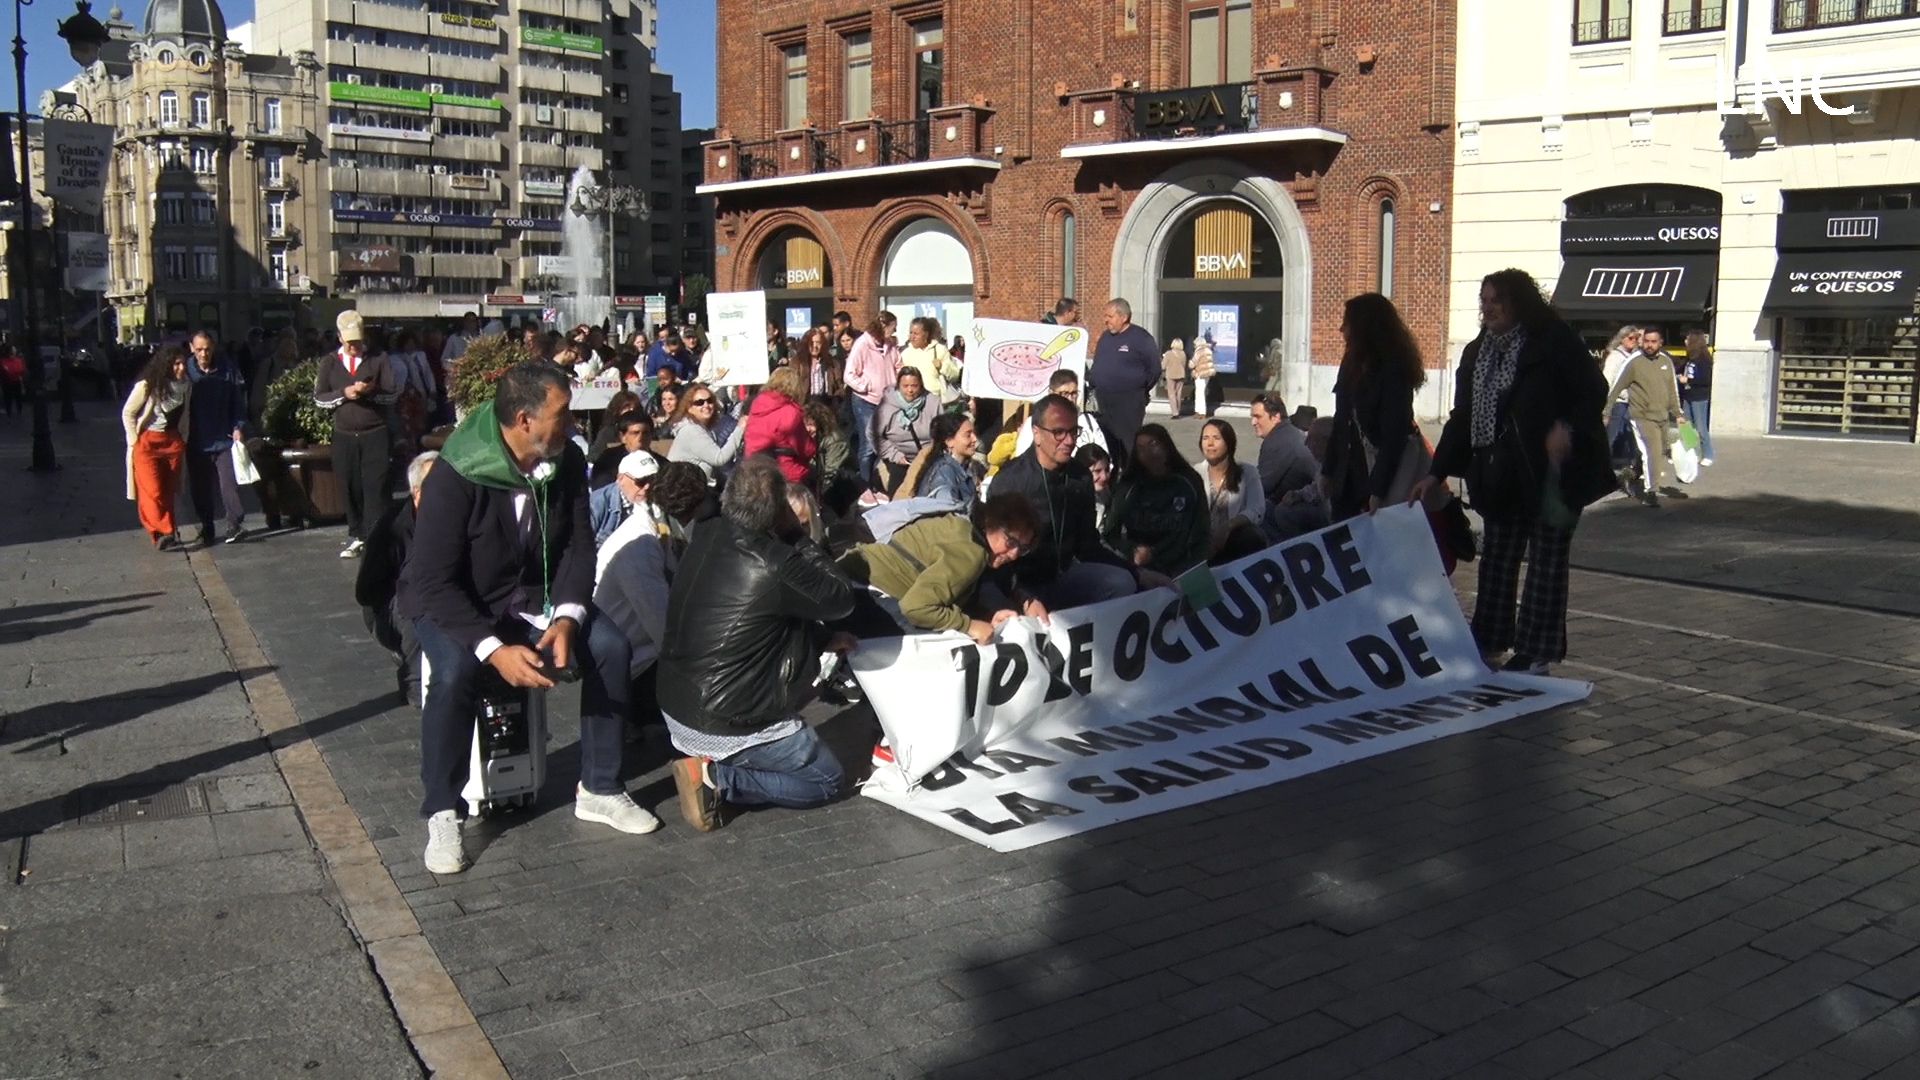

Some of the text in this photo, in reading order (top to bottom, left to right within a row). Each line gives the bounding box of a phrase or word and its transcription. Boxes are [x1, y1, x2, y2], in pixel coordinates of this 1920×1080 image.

[1146, 90, 1224, 125] BBVA
[60, 156, 100, 168] House
[62, 168, 99, 178] of the
[57, 177, 101, 189] Dragon
[410, 214, 441, 224] OCASO
[506, 218, 535, 228] OCASO
[1658, 227, 1719, 243] QUESOS
[1196, 253, 1247, 272] BBVA
[787, 268, 820, 284] BBVA
[1789, 271, 1903, 280] UN CONTENEDOR
[1791, 281, 1895, 294] de QUESOS
[791, 309, 806, 323] Ya
[1201, 309, 1236, 323] Entra
[1113, 523, 1373, 680] OCTUBRE
[1046, 658, 1366, 757] MUNDIAL
[1346, 614, 1442, 690] DE
[940, 684, 1548, 835] LA SALUD MENTAL
